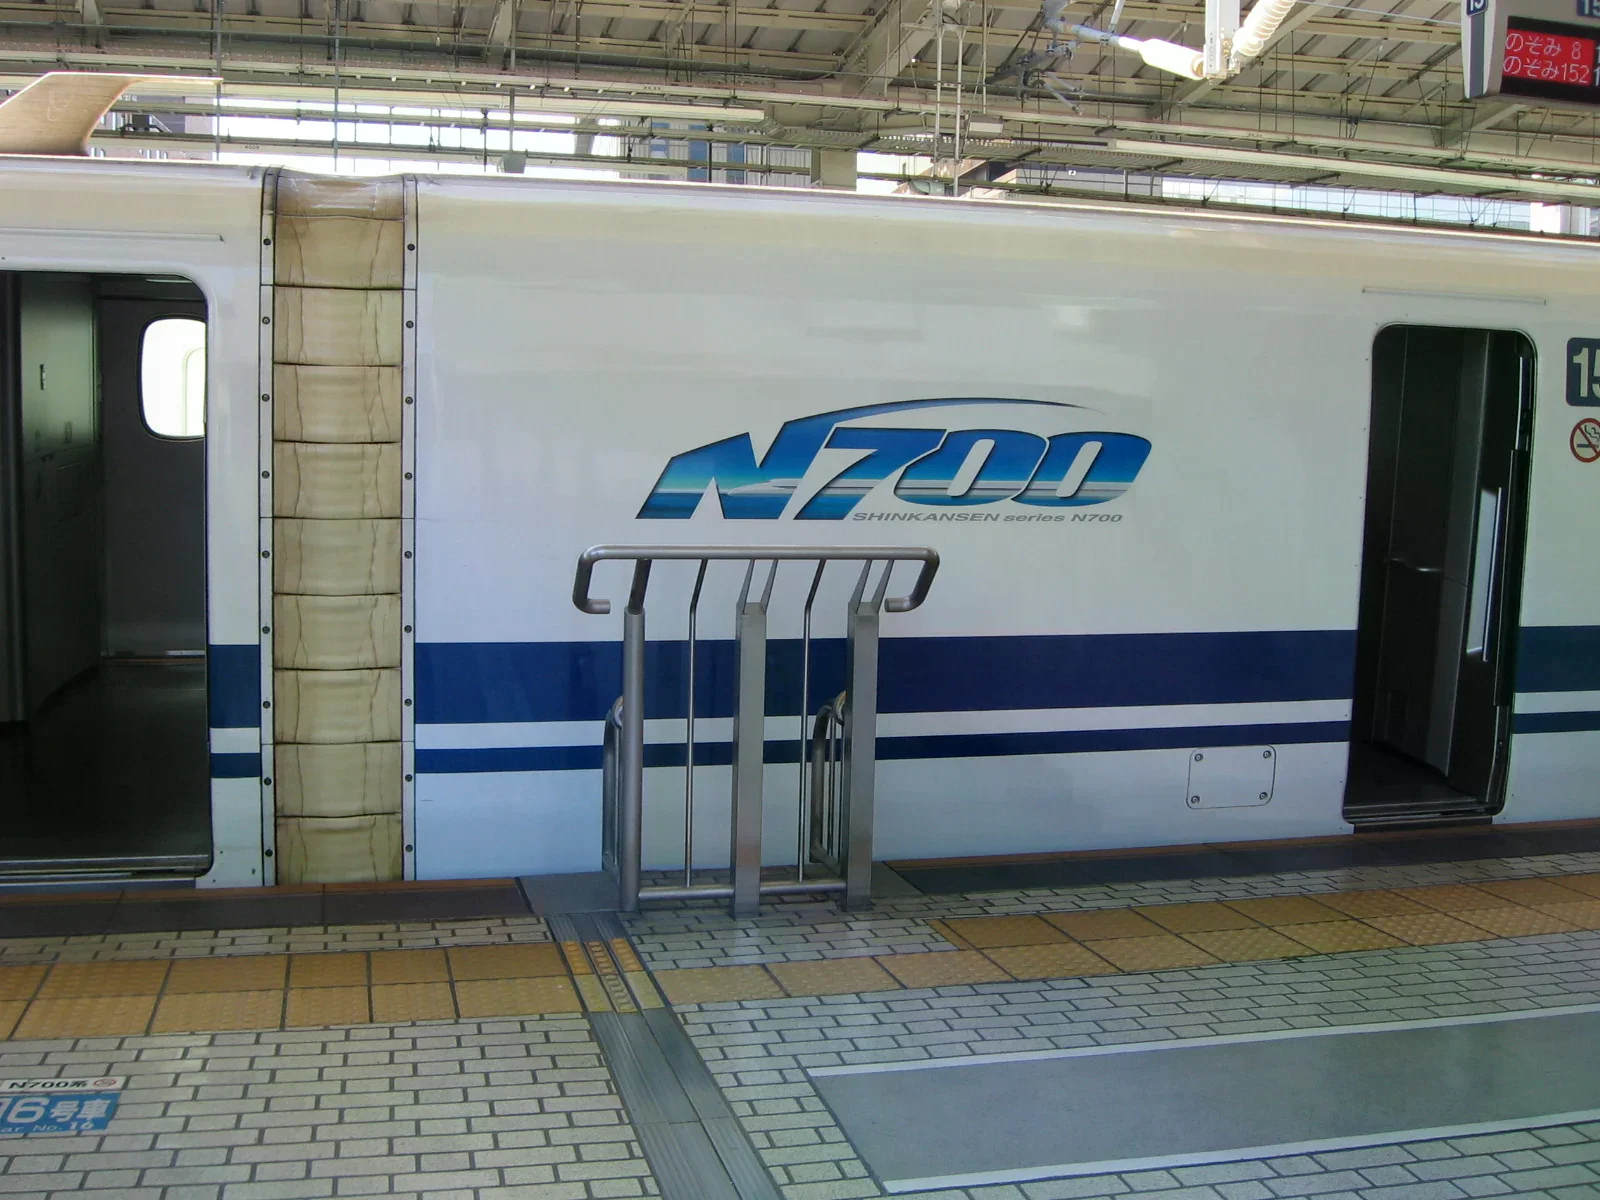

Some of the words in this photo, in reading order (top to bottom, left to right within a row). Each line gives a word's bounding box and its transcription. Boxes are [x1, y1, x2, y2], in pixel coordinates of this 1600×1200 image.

[1506, 33, 1562, 57] のぞみ
[1571, 41, 1582, 60] 8
[635, 397, 1153, 521] N700
[852, 512, 1001, 522] SHINKANSEN
[1003, 513, 1064, 523] series
[1070, 513, 1123, 523] N700
